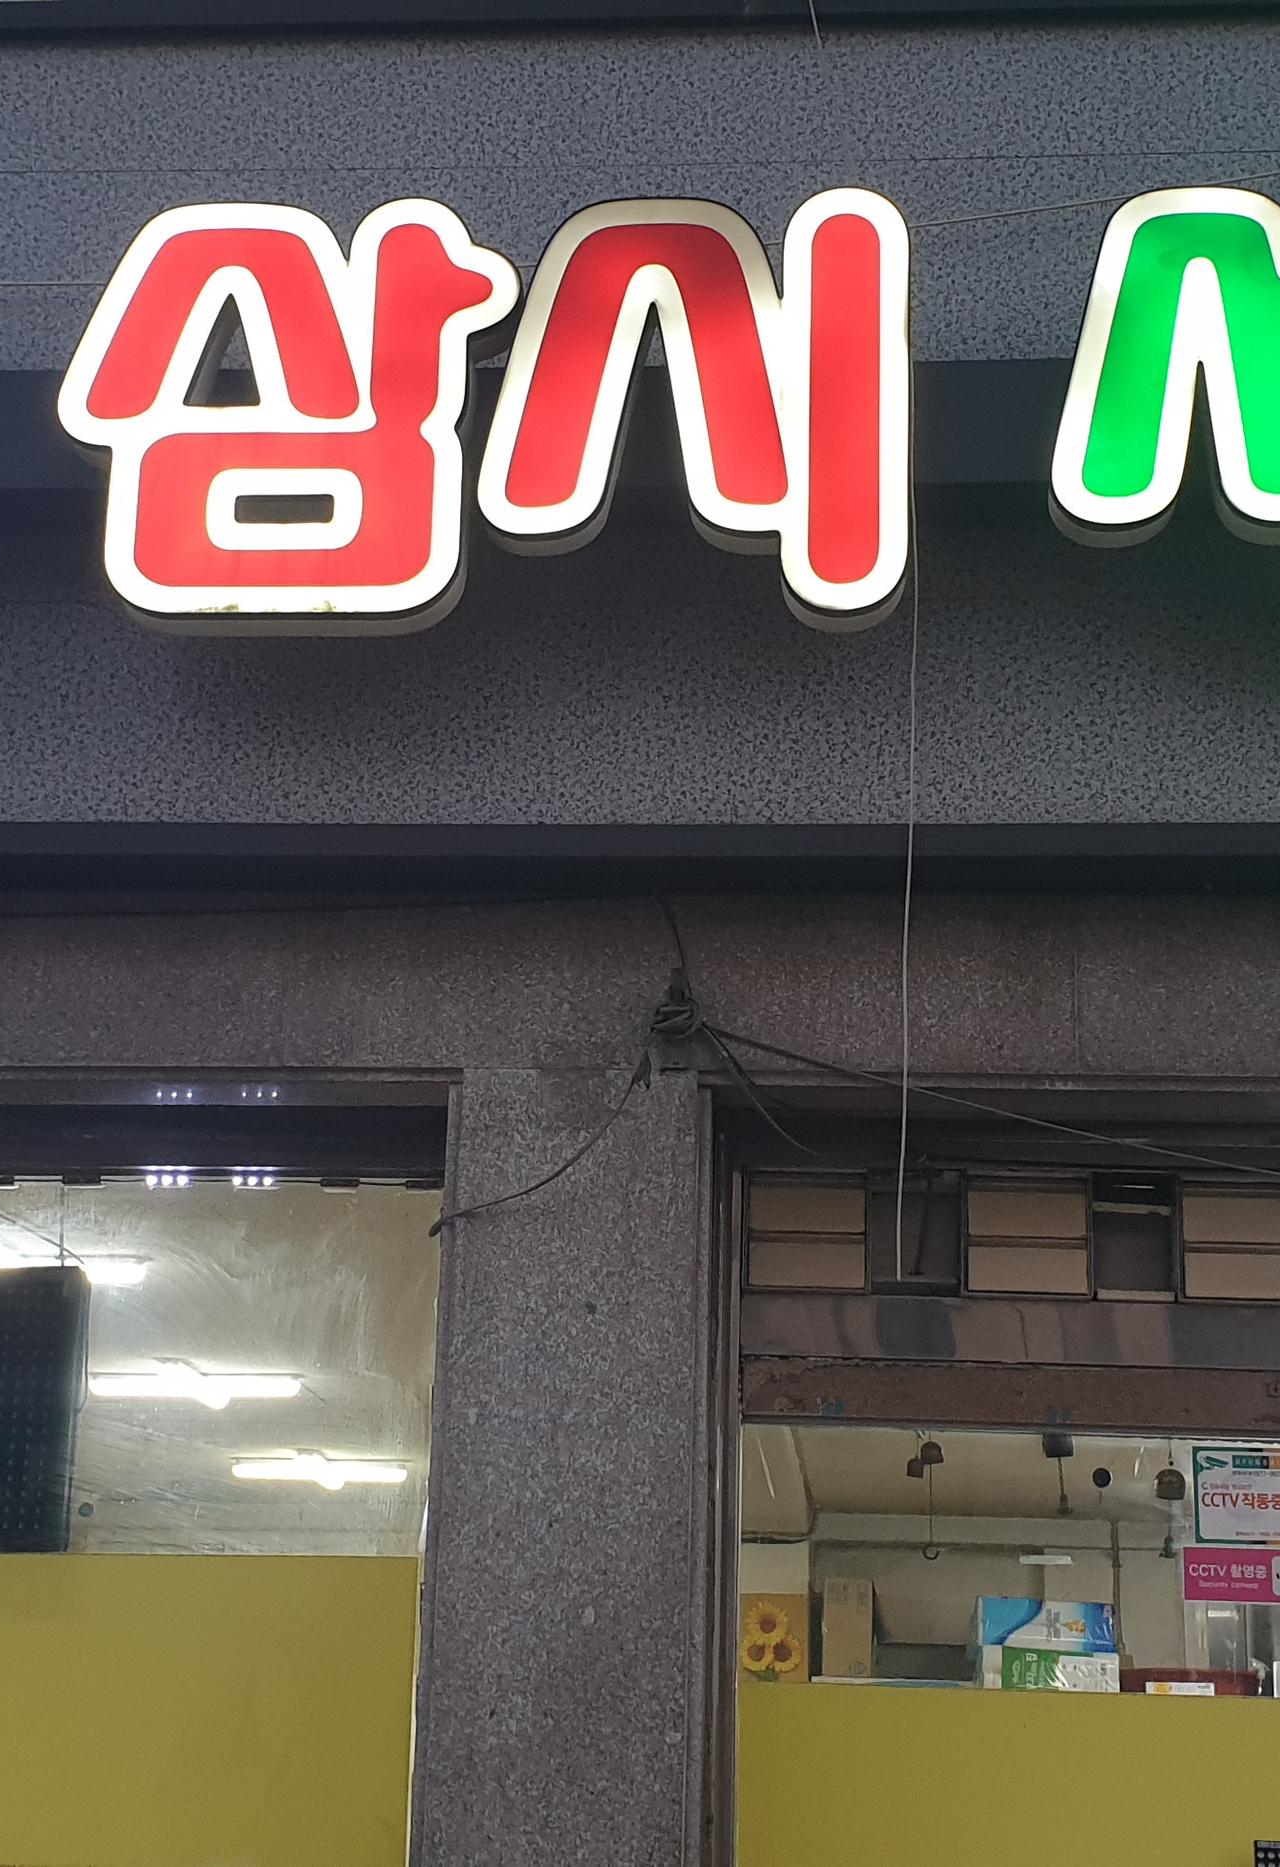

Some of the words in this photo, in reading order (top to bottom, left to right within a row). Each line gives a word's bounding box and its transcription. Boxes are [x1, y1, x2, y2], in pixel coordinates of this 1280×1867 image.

[58, 188, 910, 614] 삼시
[1201, 1492, 1239, 1508] CCTV
[1189, 1564, 1227, 1577] CCTV
